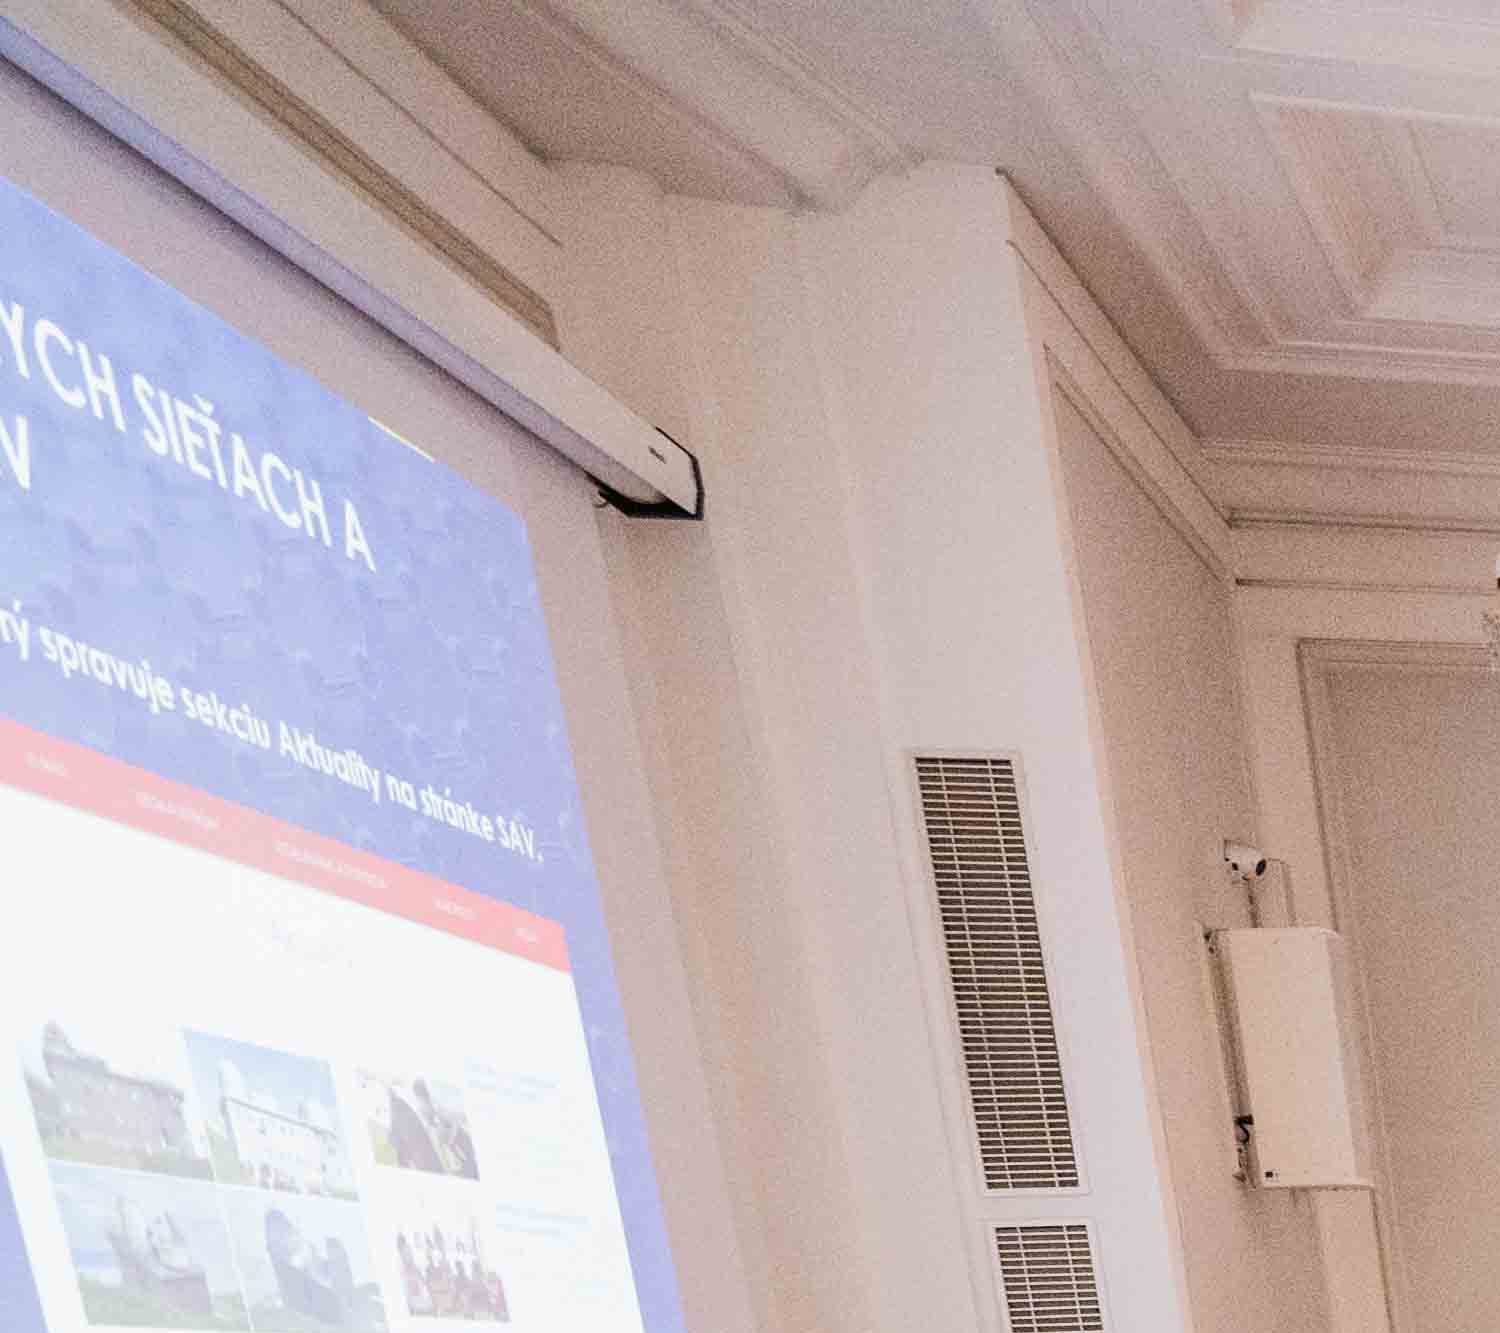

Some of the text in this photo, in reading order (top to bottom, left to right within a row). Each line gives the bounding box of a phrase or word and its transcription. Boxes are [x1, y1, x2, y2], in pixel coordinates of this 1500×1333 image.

[132, 372, 331, 547] SIEŤACH
[345, 499, 376, 573] A
[39, 625, 176, 716] spravuje
[181, 687, 271, 750] sekciu
[279, 720, 380, 804] Aktuality
[384, 773, 417, 811] na
[419, 784, 495, 842] stránke
[495, 814, 544, 864] SAV.
